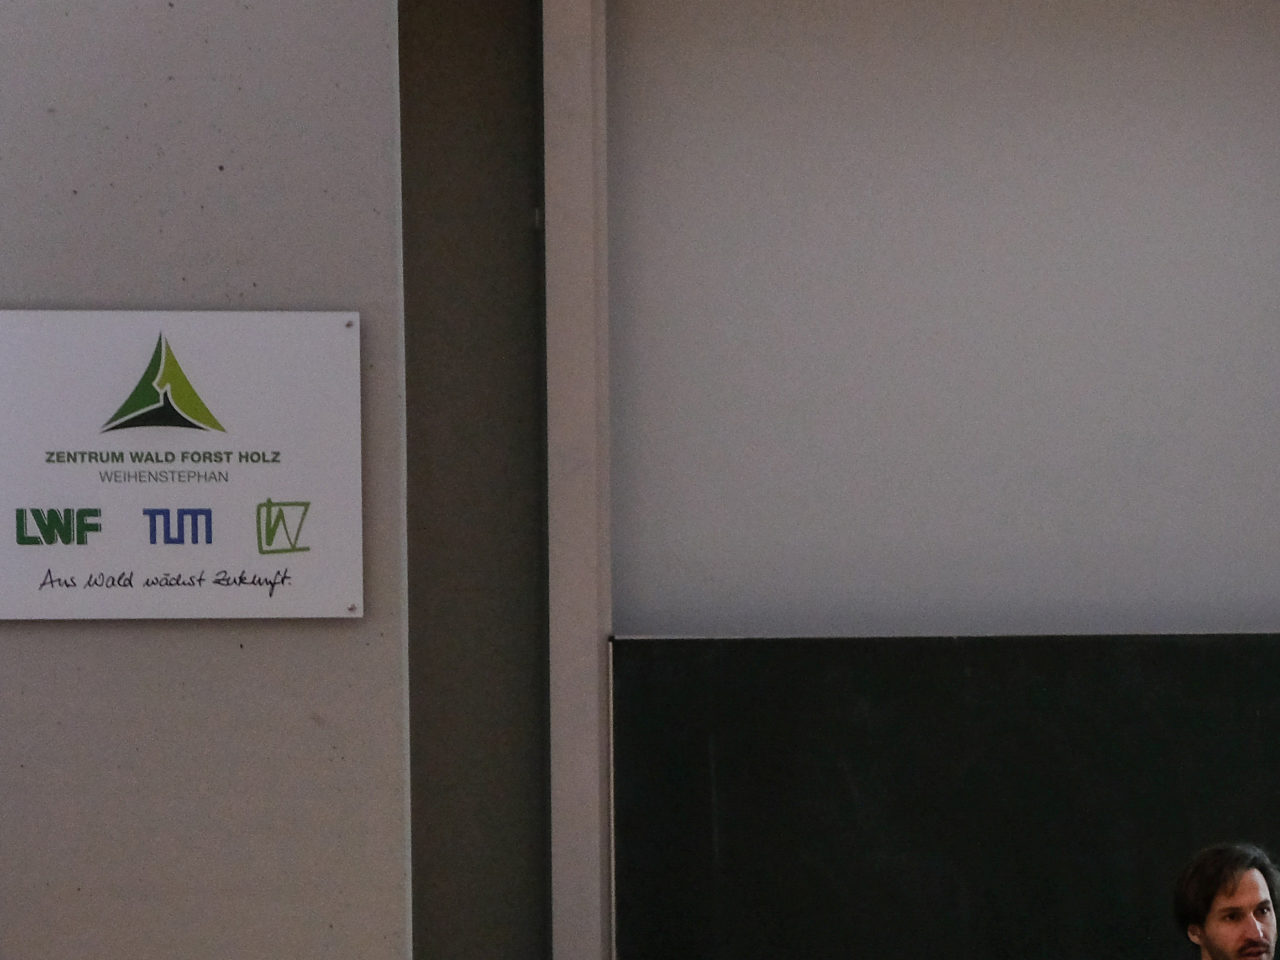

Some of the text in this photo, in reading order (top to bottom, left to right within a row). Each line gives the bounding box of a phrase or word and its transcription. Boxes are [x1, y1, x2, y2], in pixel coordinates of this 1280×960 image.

[45, 451, 281, 464] ZENTRUM WALD FORST HOLZ
[99, 470, 229, 483] WEIHENSTEPHAN
[15, 508, 102, 546] LWF
[143, 508, 213, 545] TUM
[38, 568, 77, 591] Aus
[83, 571, 134, 590] Wald
